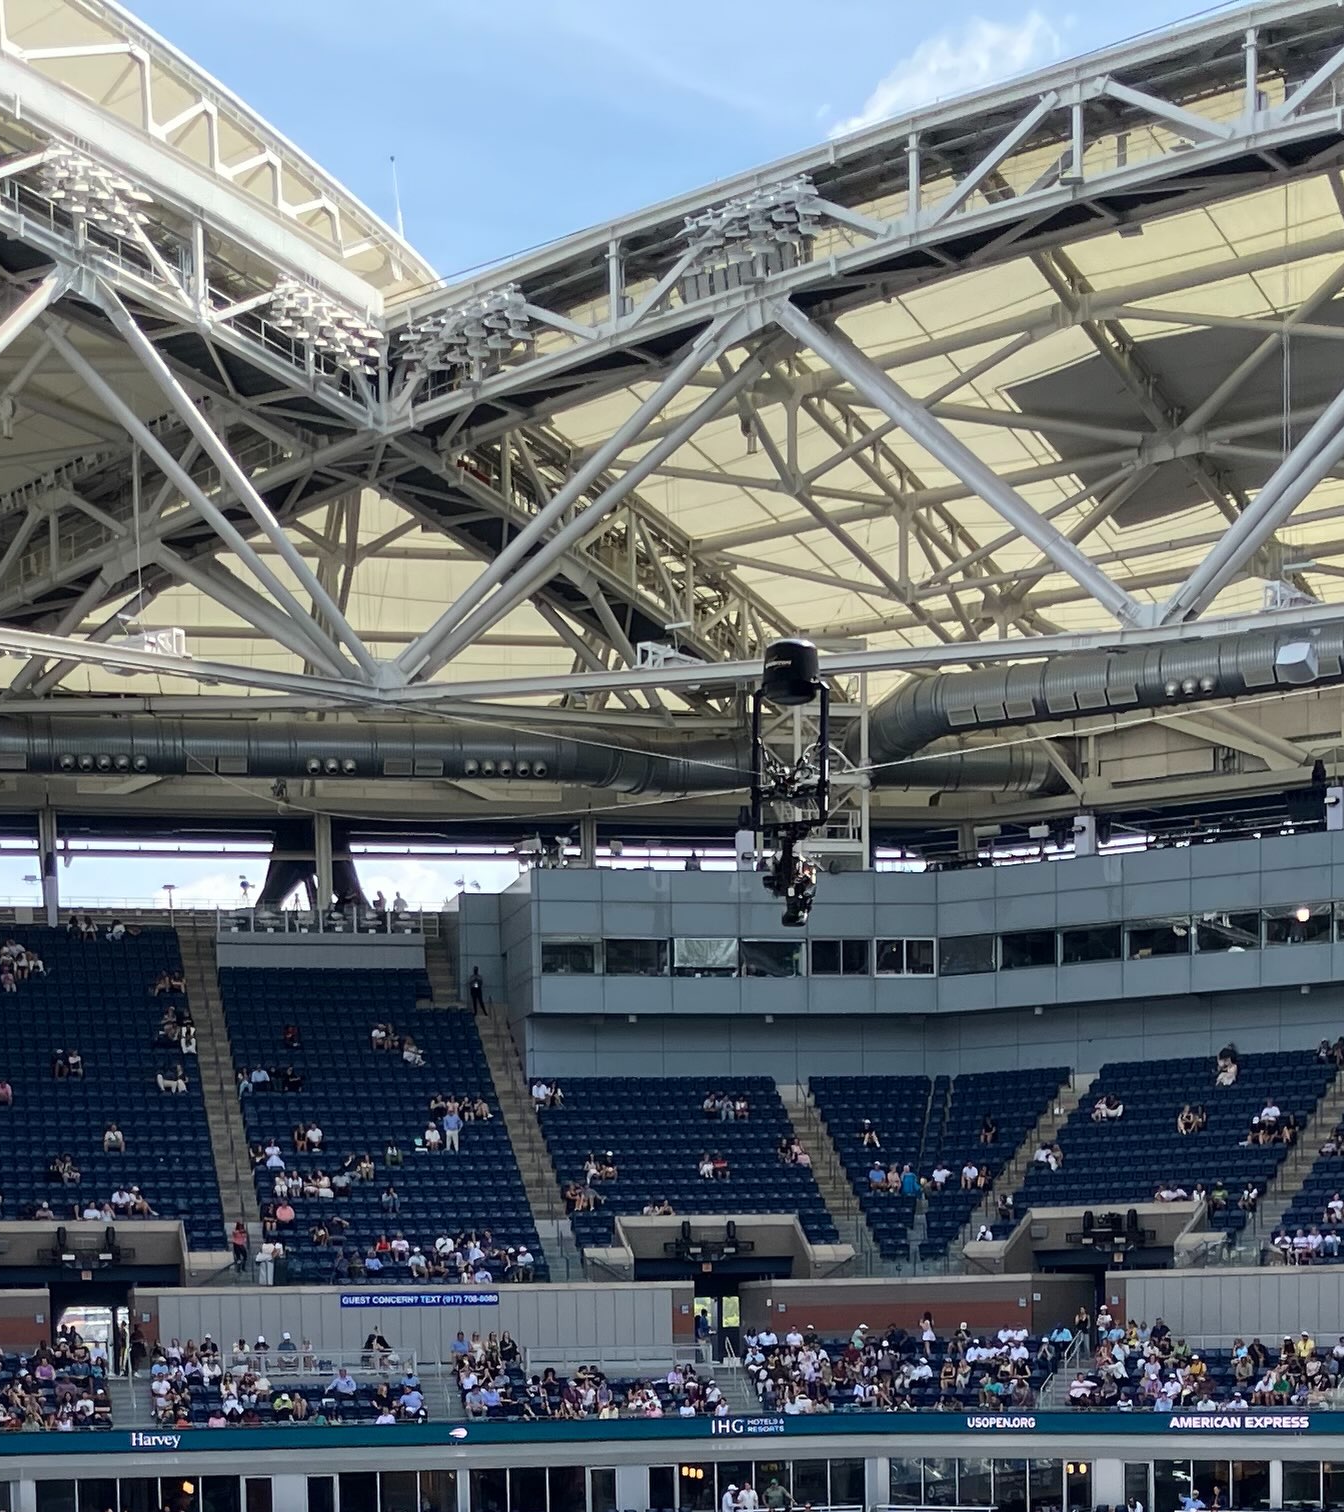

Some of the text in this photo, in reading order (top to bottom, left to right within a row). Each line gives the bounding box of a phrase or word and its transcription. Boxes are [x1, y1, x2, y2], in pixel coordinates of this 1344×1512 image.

[342, 1296, 370, 1304] GUEST
[372, 1296, 418, 1304] CONCERN?
[711, 1419, 744, 1434] IHG
[967, 1416, 1036, 1429] USOPEN.ORG
[1169, 1416, 1309, 1429] AMERICAN EXPRESS
[131, 1432, 182, 1449] Harvey
